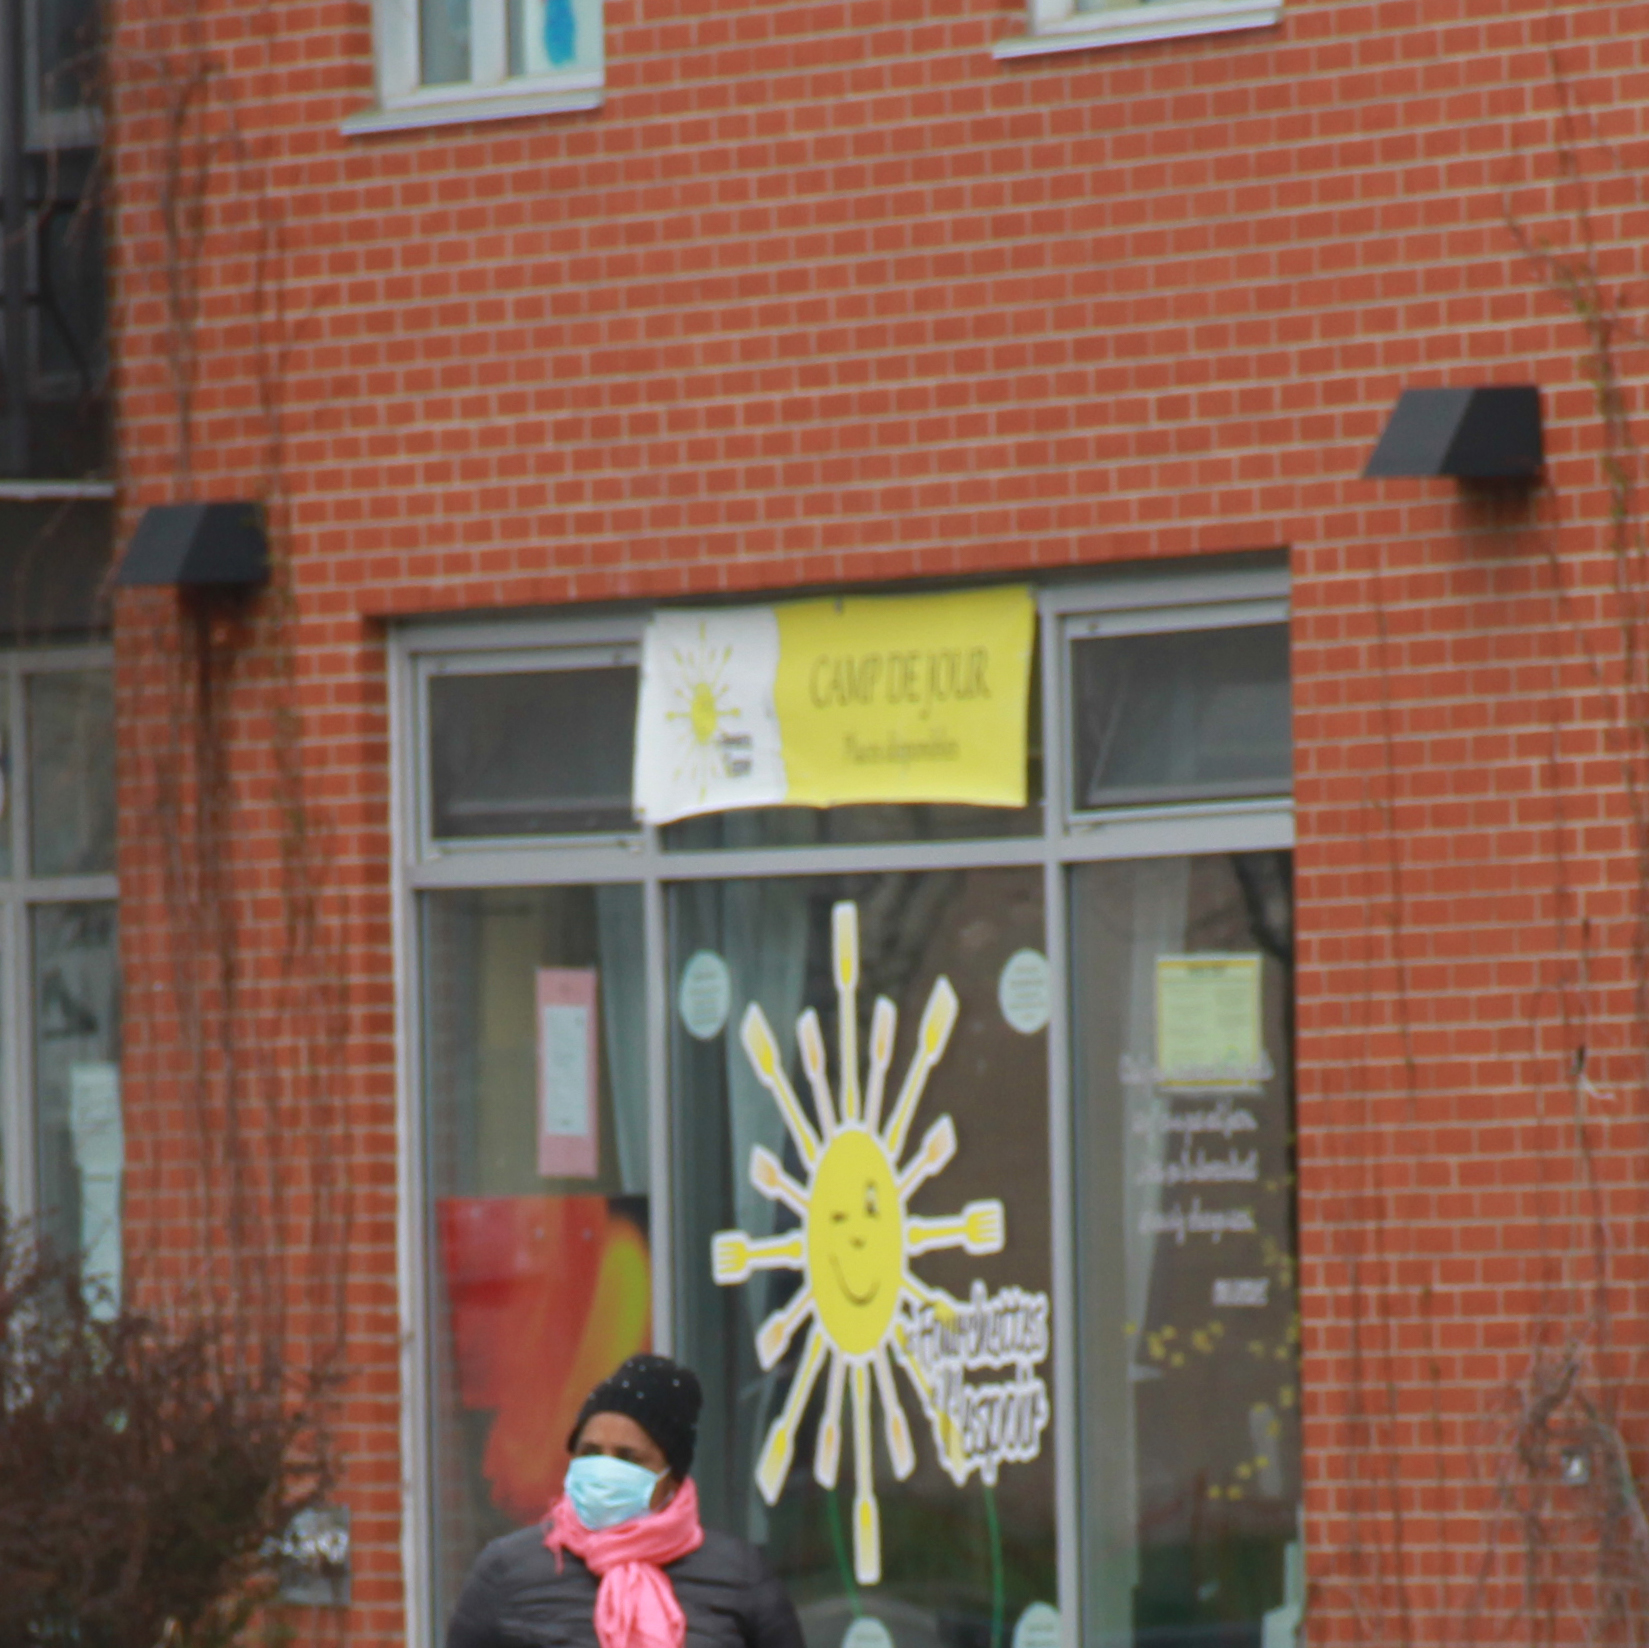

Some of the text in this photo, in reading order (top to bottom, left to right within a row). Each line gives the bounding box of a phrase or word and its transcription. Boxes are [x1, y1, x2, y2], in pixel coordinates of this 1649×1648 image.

[809, 646, 992, 721] CAMP DE JOUR
